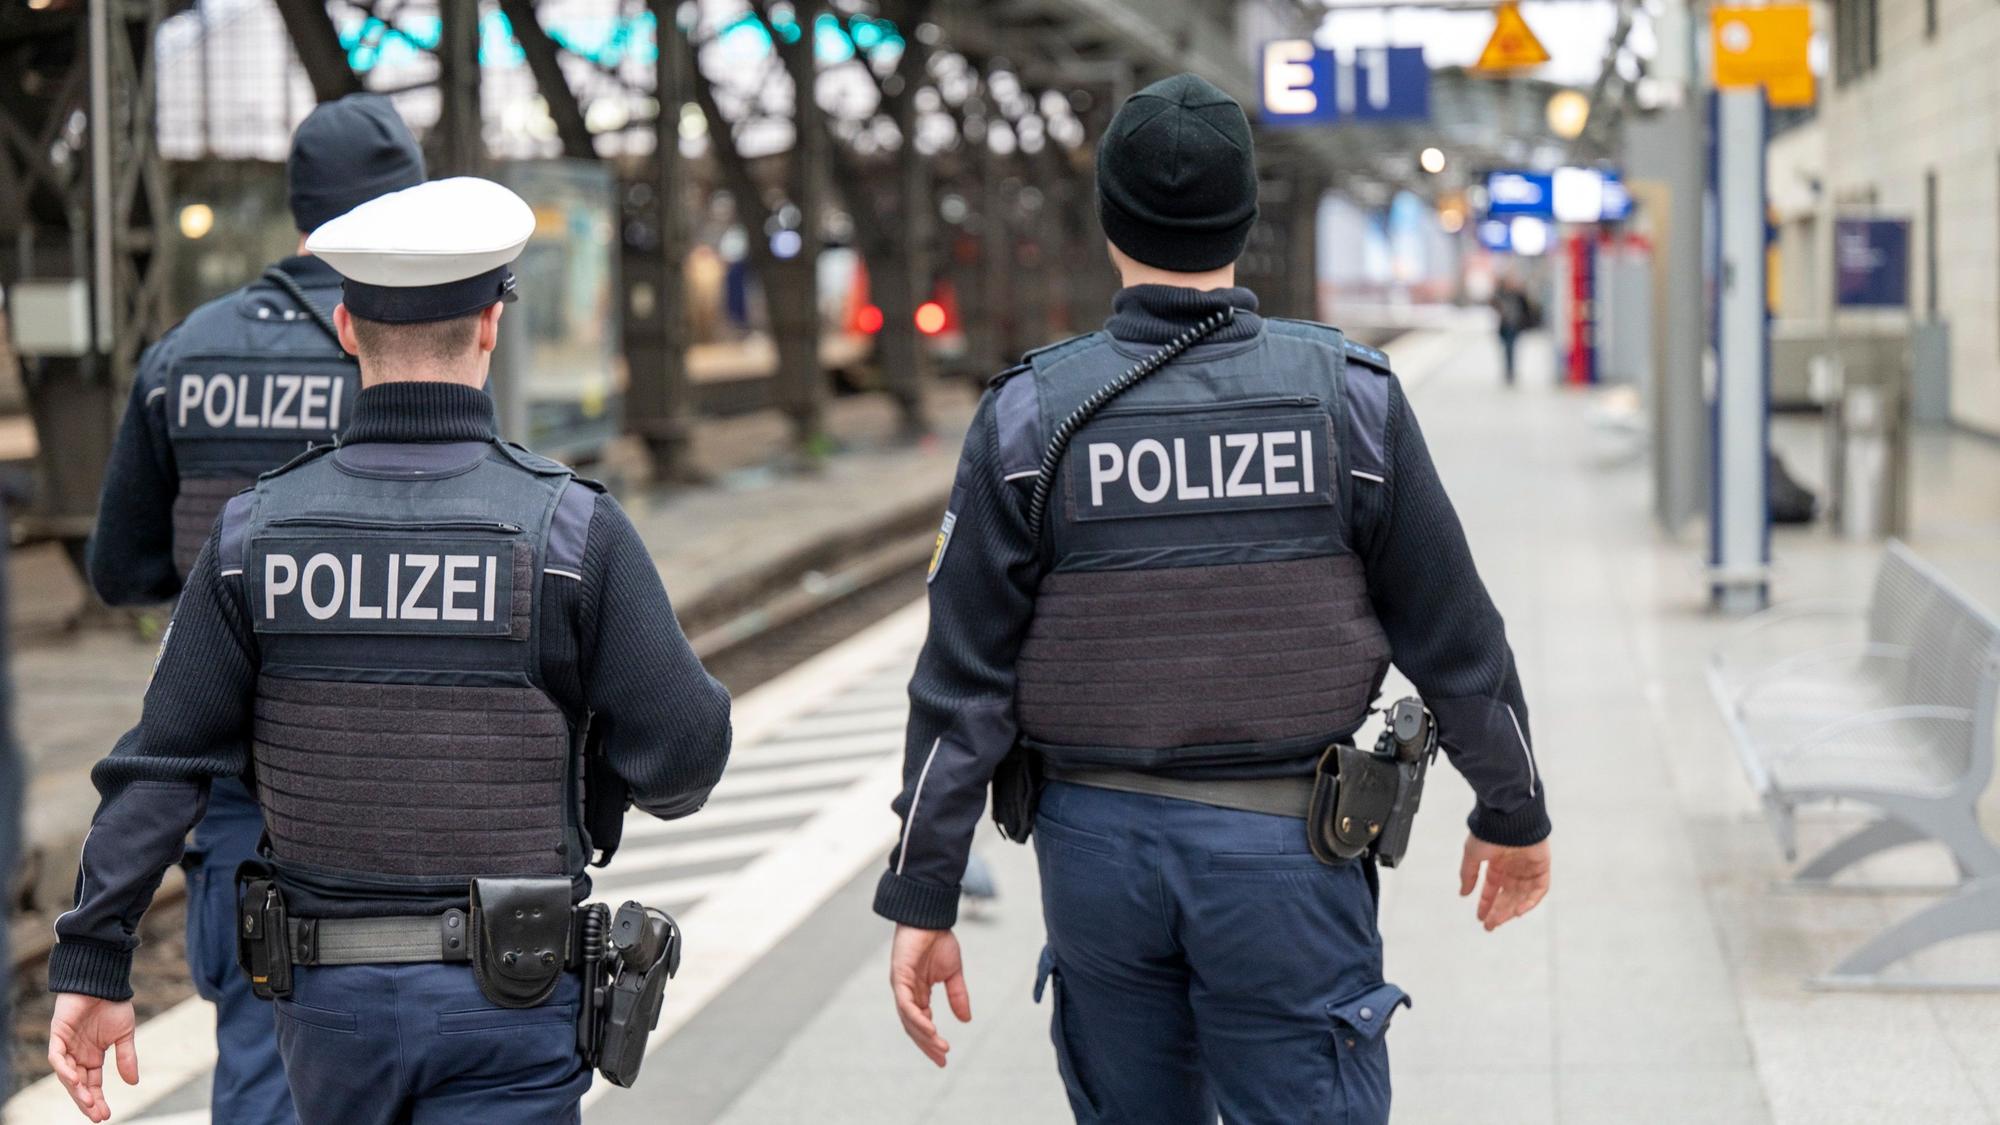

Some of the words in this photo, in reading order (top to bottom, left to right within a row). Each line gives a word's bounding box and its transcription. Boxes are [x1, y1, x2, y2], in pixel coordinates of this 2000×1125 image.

[1264, 39, 1317, 114] E
[179, 374, 344, 428] POLIZEI
[1088, 430, 1315, 506] POLIZEI
[264, 552, 497, 621] POLIZEI
